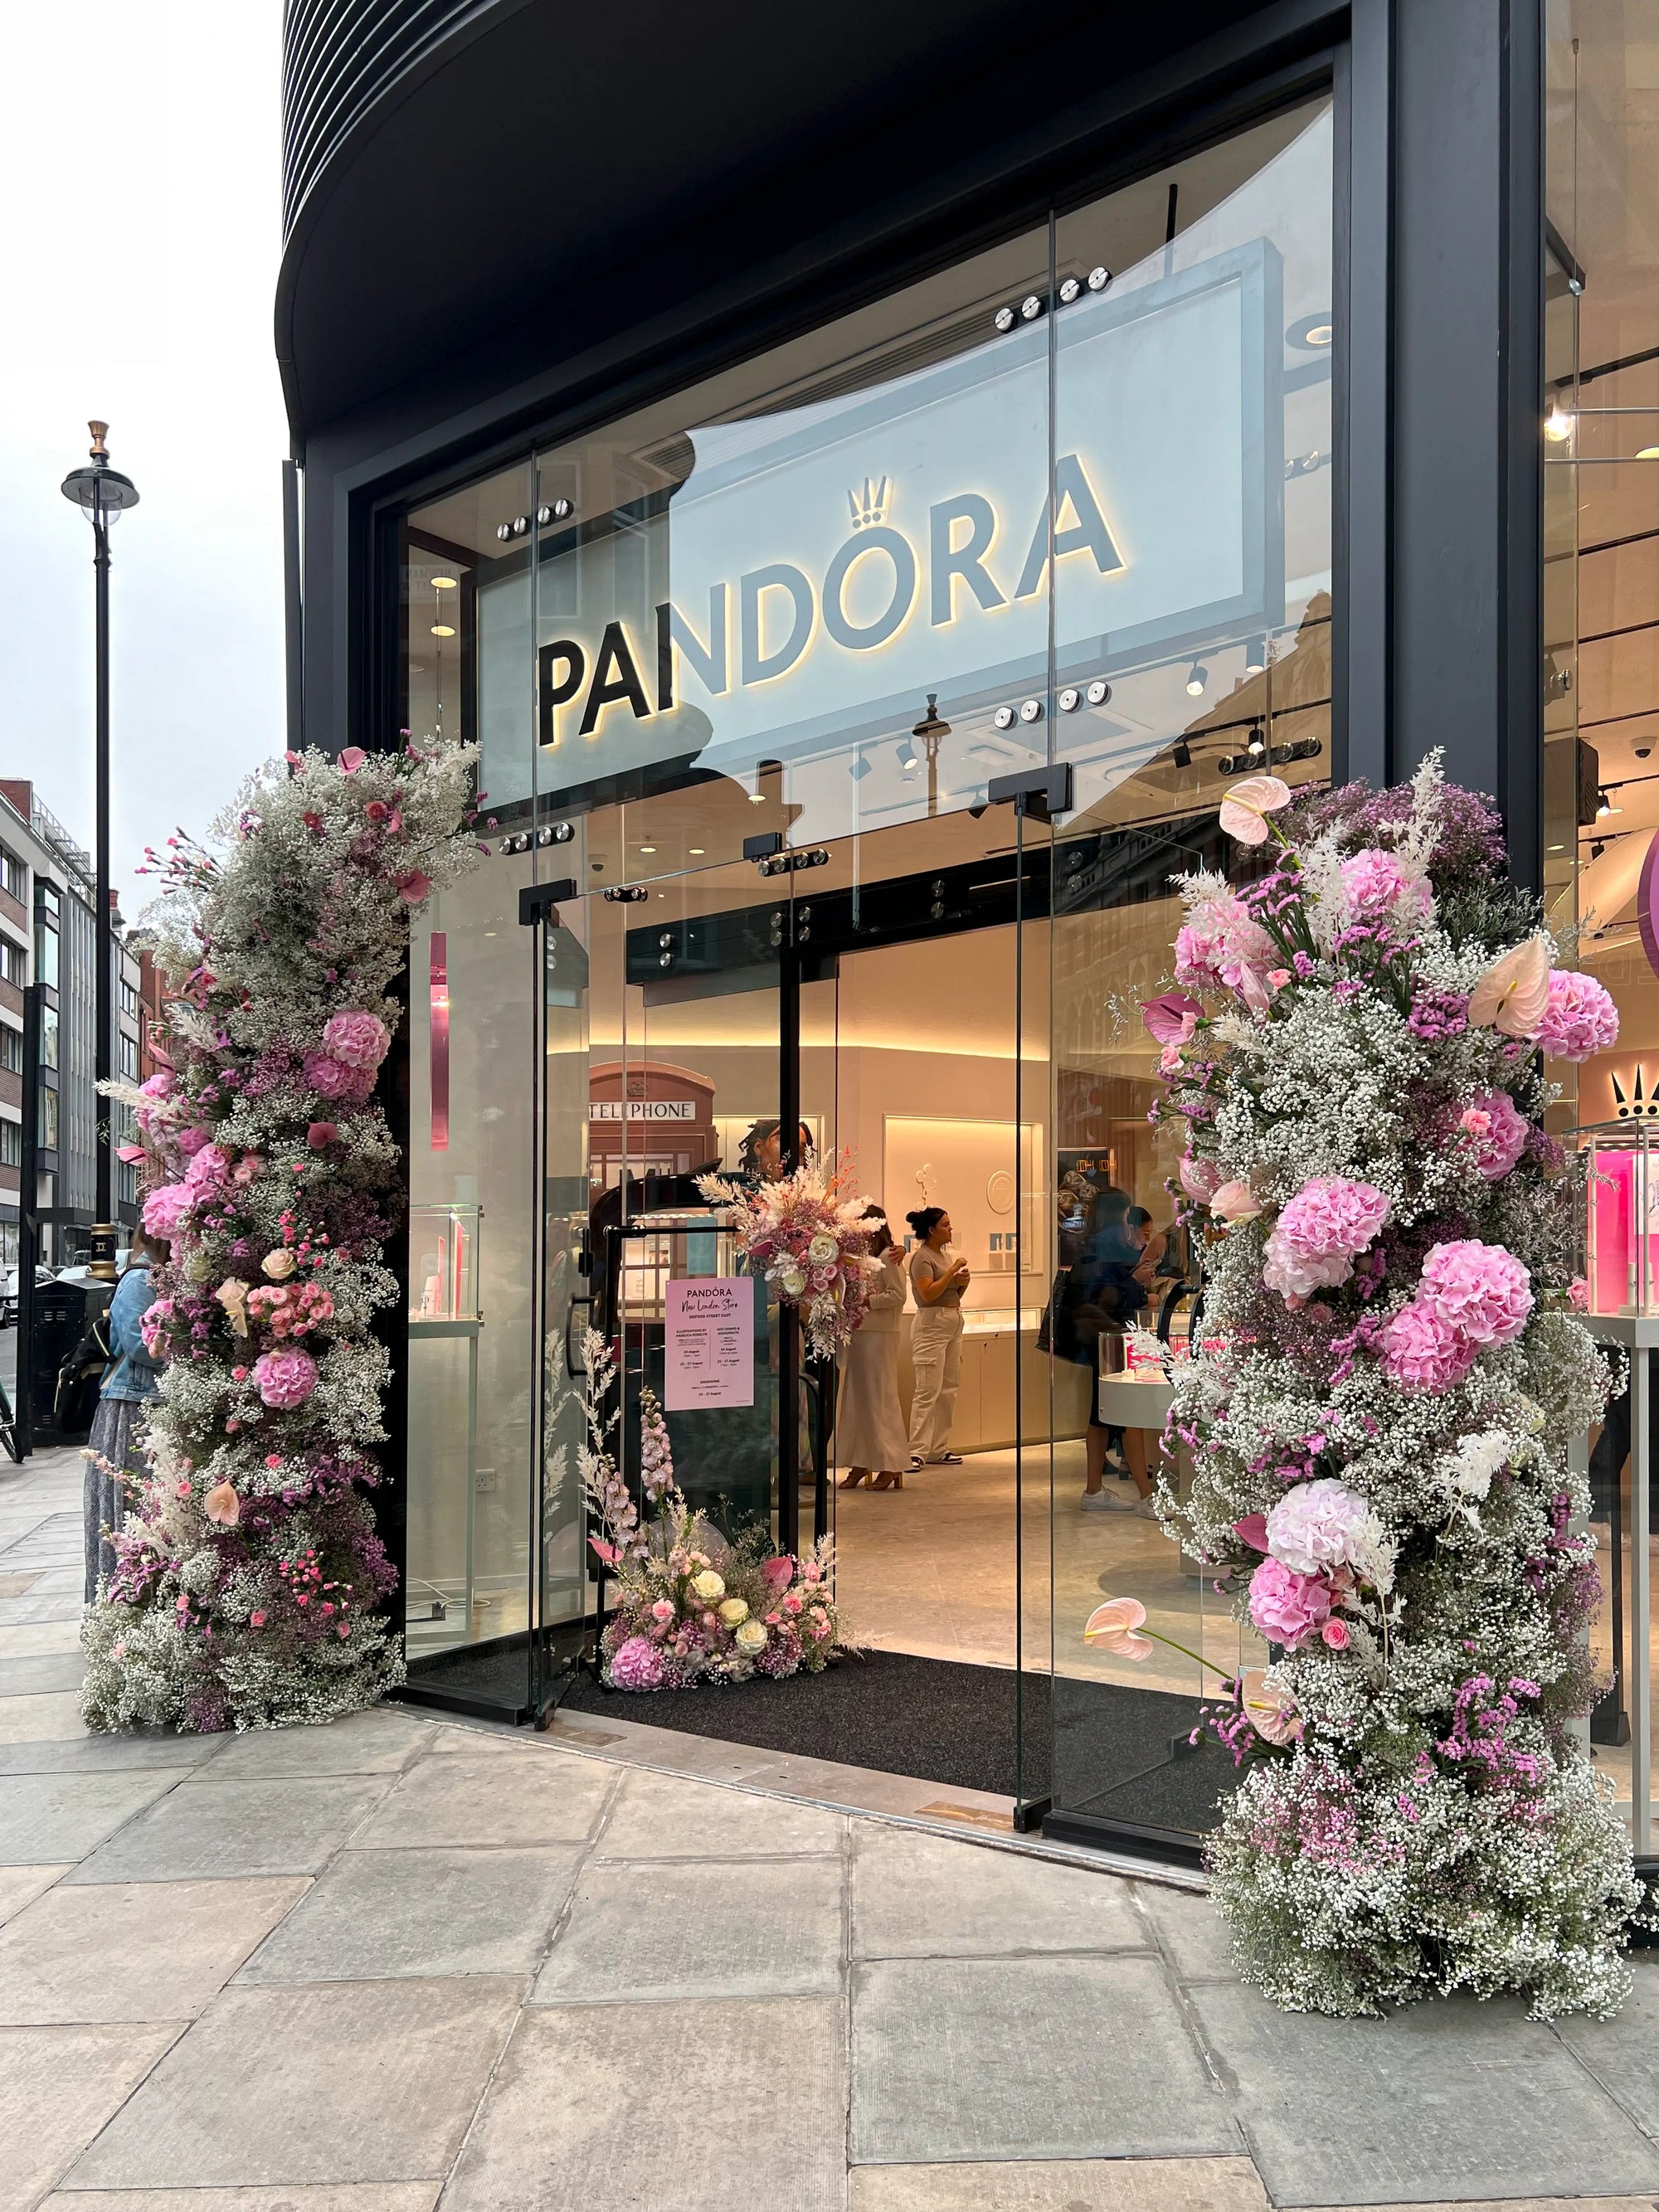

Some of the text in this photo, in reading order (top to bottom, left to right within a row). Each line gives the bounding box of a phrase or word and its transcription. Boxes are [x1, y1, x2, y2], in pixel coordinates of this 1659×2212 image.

[538, 453, 1126, 748] PANDORA
[589, 1103, 691, 1118] TELPHONE
[687, 1288, 732, 1298] PANDORA
[681, 1298, 737, 1312] New London Store
